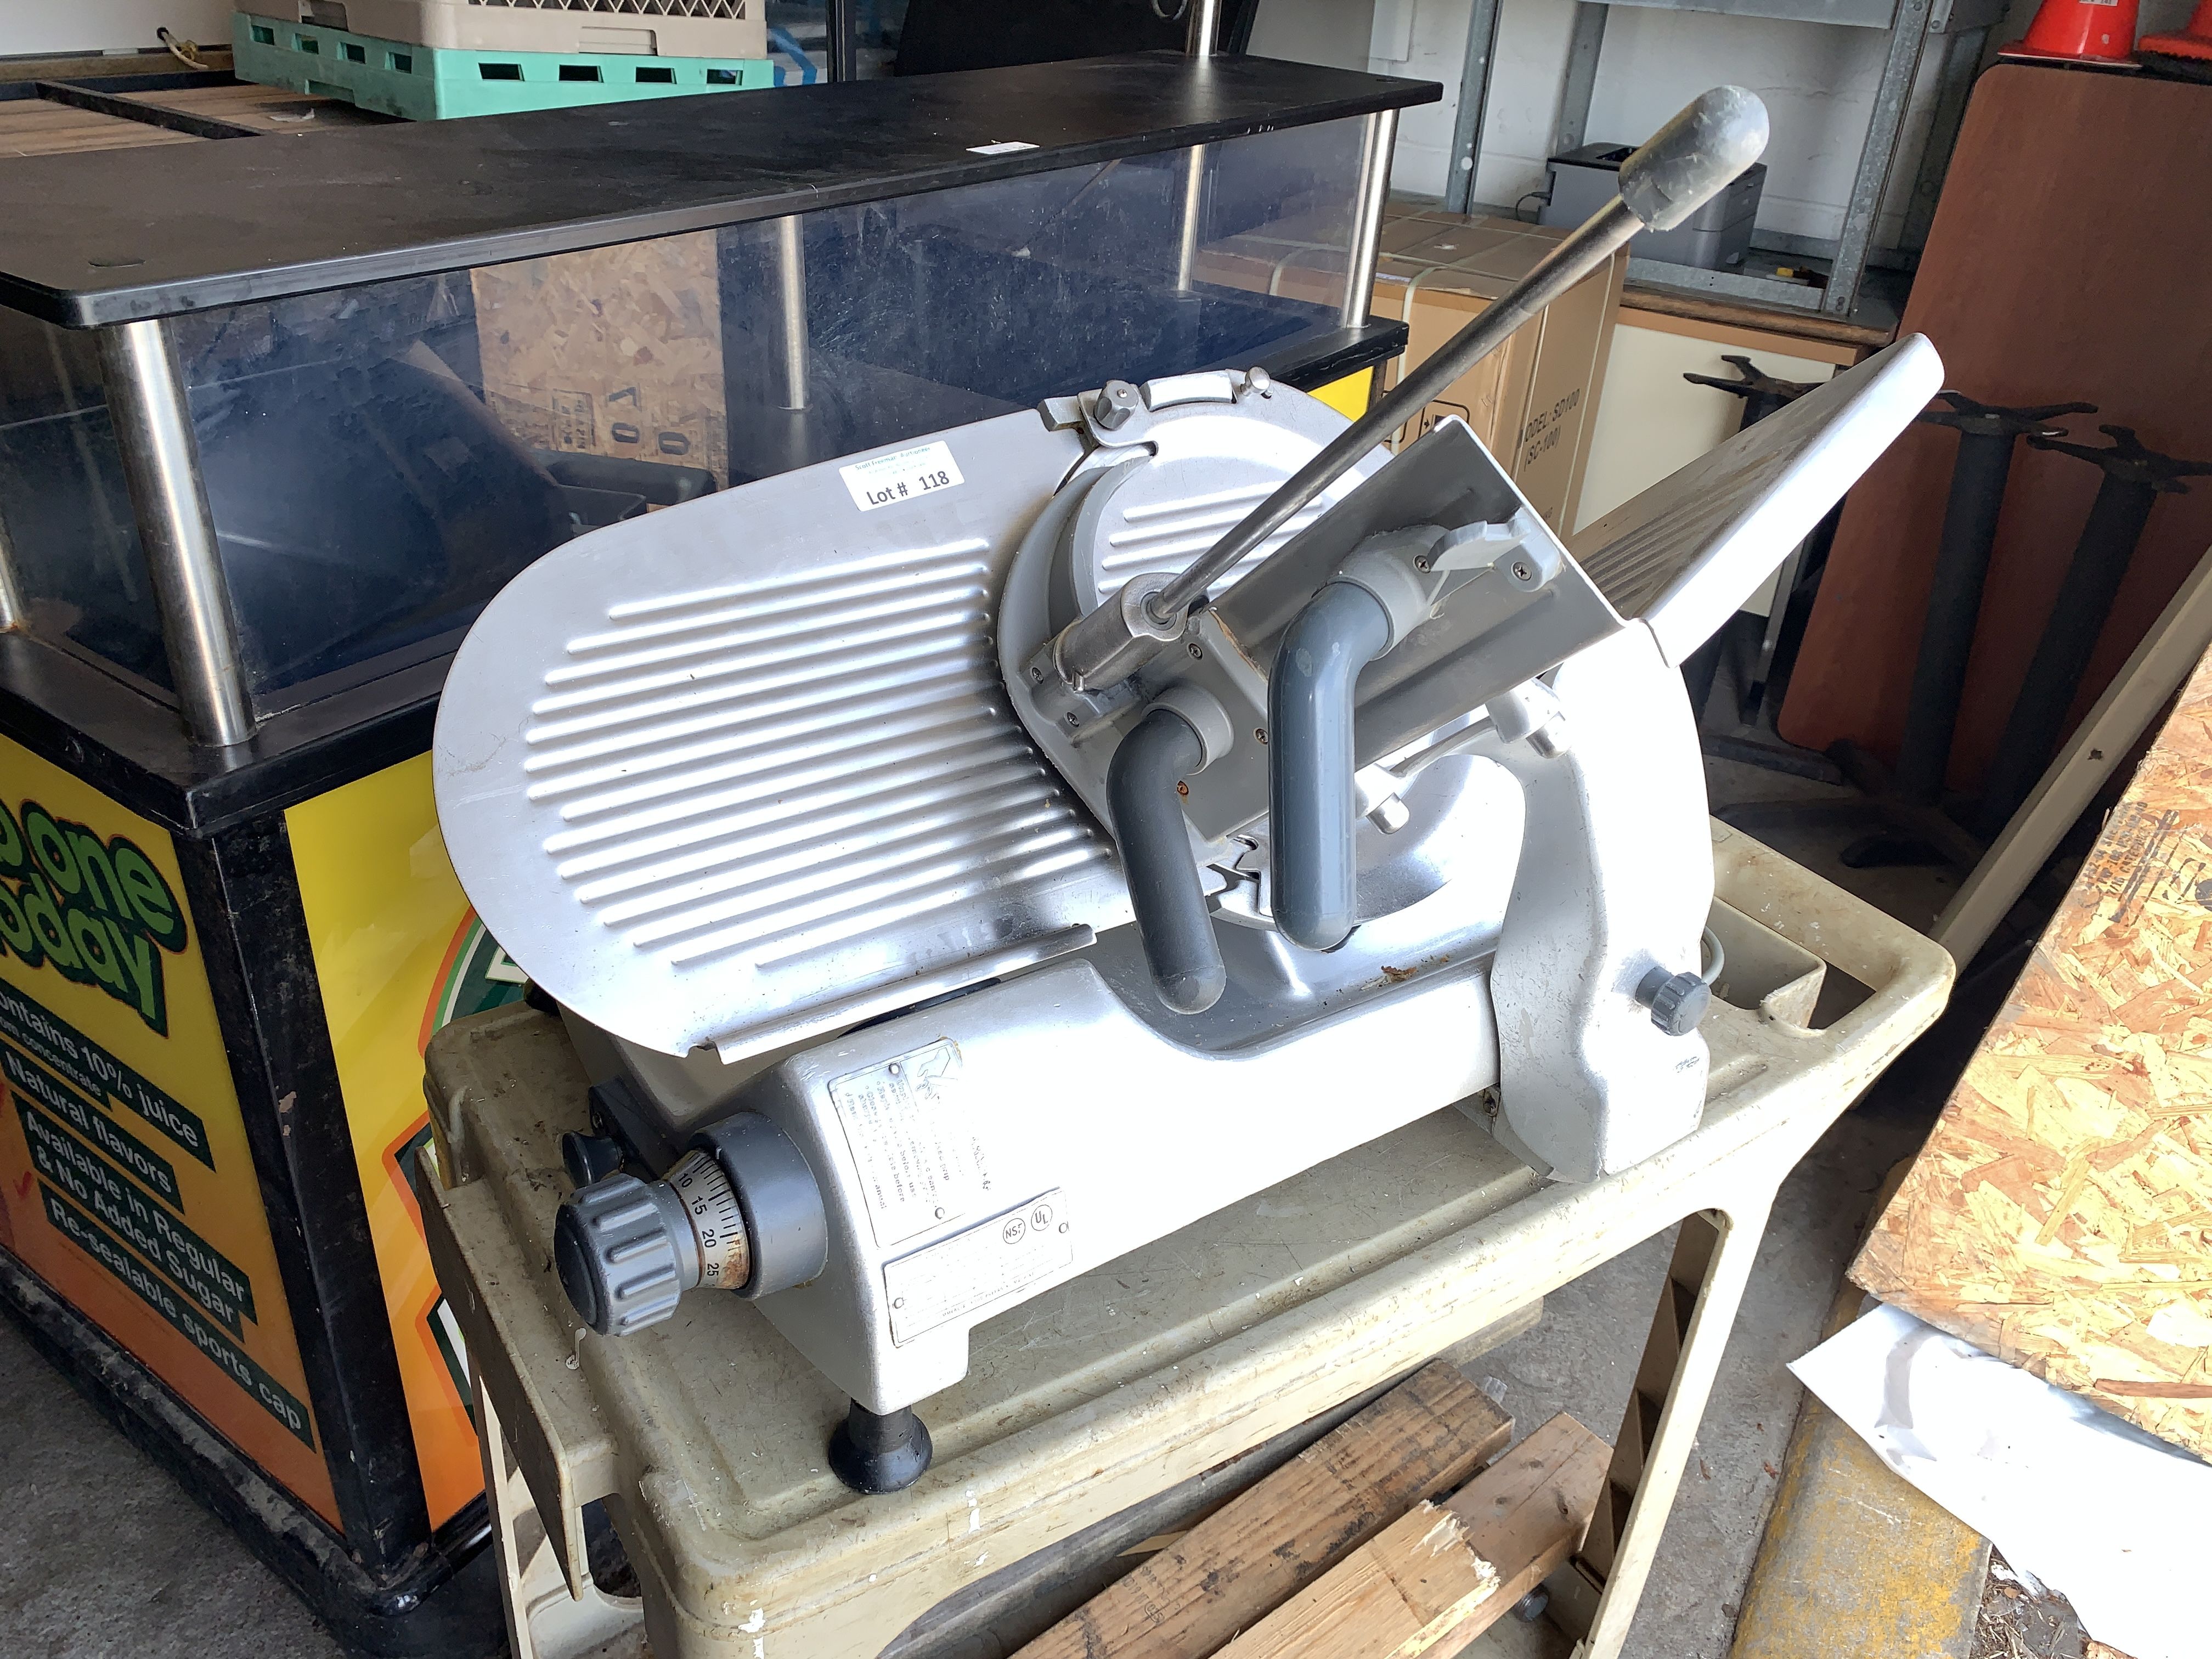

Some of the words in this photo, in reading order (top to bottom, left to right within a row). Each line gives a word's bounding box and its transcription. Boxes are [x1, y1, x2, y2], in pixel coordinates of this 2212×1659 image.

[866, 487, 896, 505] Lot
[897, 482, 908, 497] #
[919, 471, 950, 490] 118
[27, 812, 175, 935] one
[22, 1032, 101, 1096] concentrate
[5, 1050, 90, 1130] Natural
[92, 1115, 172, 1193] flavors
[81, 1046, 133, 1099] 10%
[137, 1083, 199, 1147] juice
[27, 1110, 122, 1201] Available
[125, 1186, 149, 1223] in
[152, 1209, 245, 1302] Regular
[678, 1173, 693, 1188] 10
[691, 1195, 708, 1216] 15
[36, 1144, 54, 1173] &
[55, 1158, 88, 1200] No
[94, 1189, 163, 1262] Added
[166, 1251, 234, 1323] Sugar
[702, 1228, 717, 1249] 20
[1035, 1210, 1049, 1224] UL
[707, 1262, 719, 1277] 25
[50, 1198, 177, 1318] Re-sealable
[182, 1313, 253, 1386] sports
[258, 1382, 302, 1431] cap
